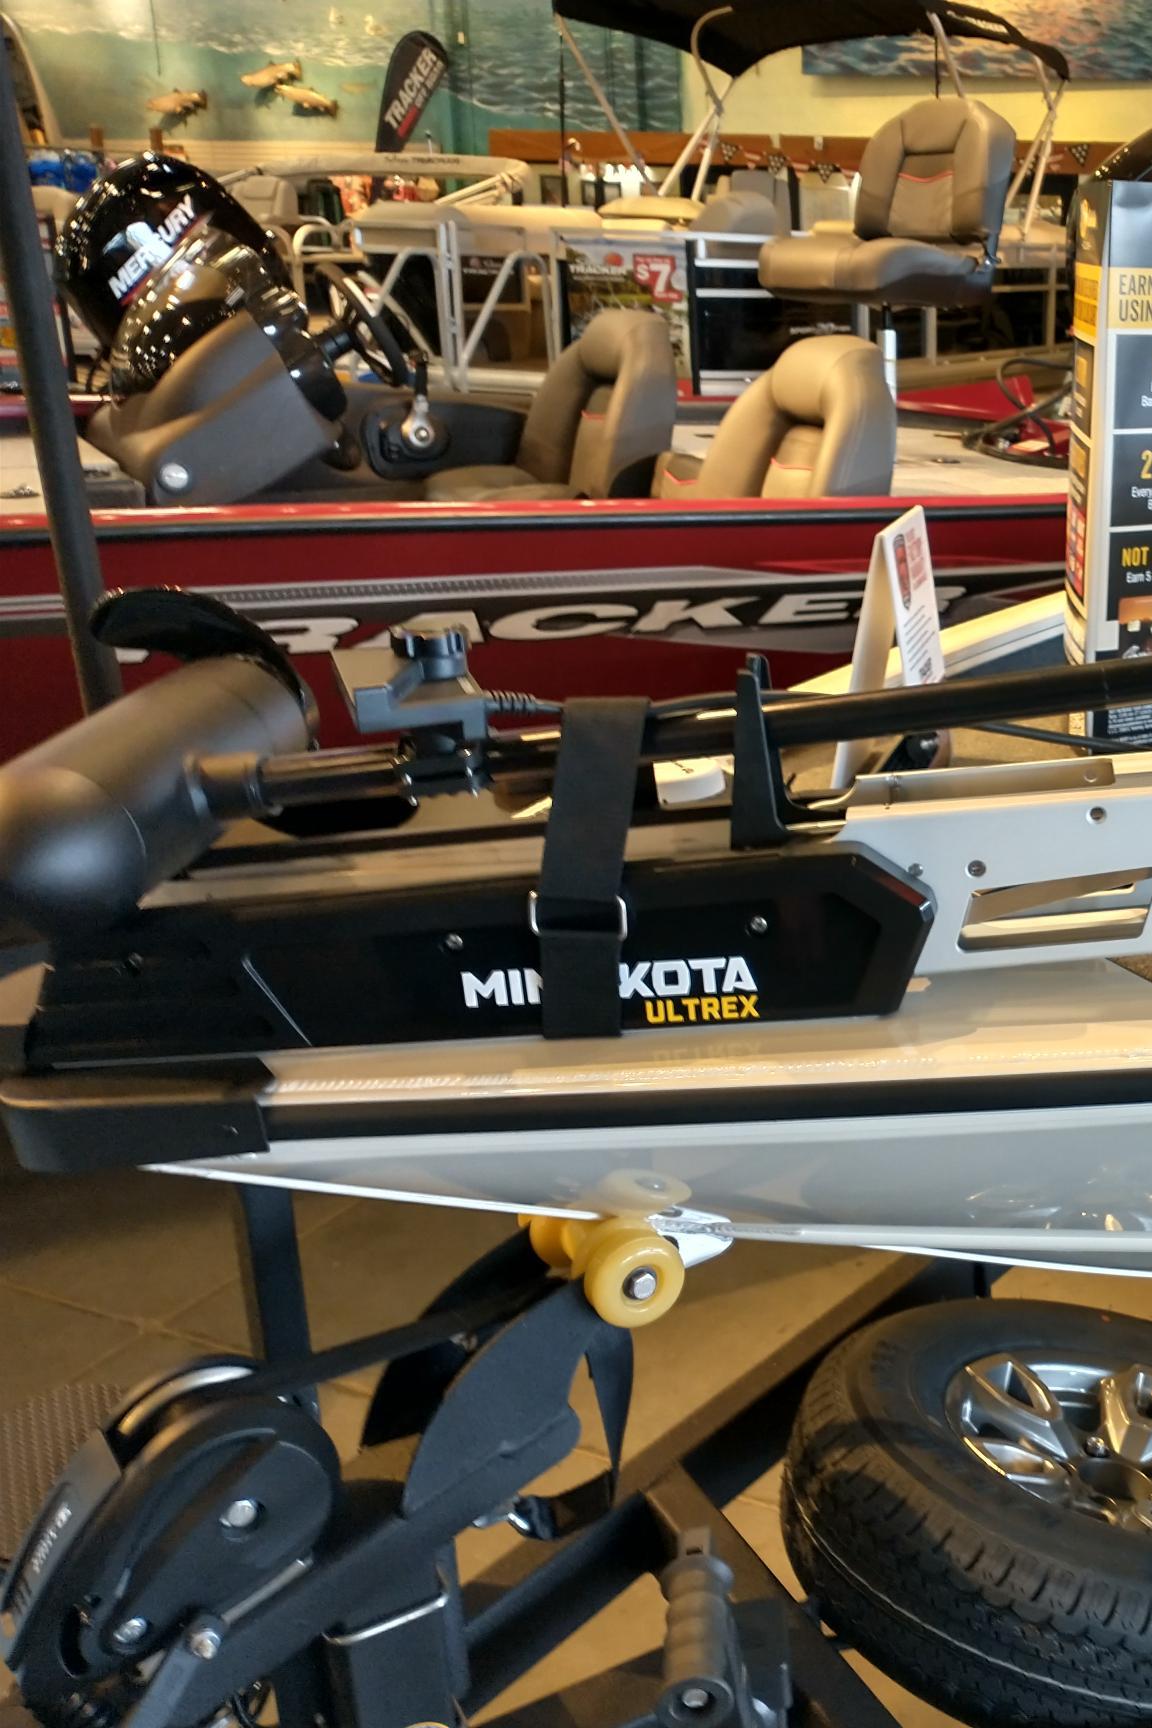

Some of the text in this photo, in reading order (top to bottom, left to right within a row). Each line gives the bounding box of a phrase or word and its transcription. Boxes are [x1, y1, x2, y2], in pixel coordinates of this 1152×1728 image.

[384, 47, 437, 131] TRACKER
[108, 194, 195, 300] MERURY
[1131, 486, 1152, 498] Every
[1122, 546, 1150, 568] NOT
[1126, 571, 1145, 583] Earn
[115, 586, 967, 664] RACKE
[618, 956, 758, 999] KOTA
[645, 994, 760, 1025] ULTREX
